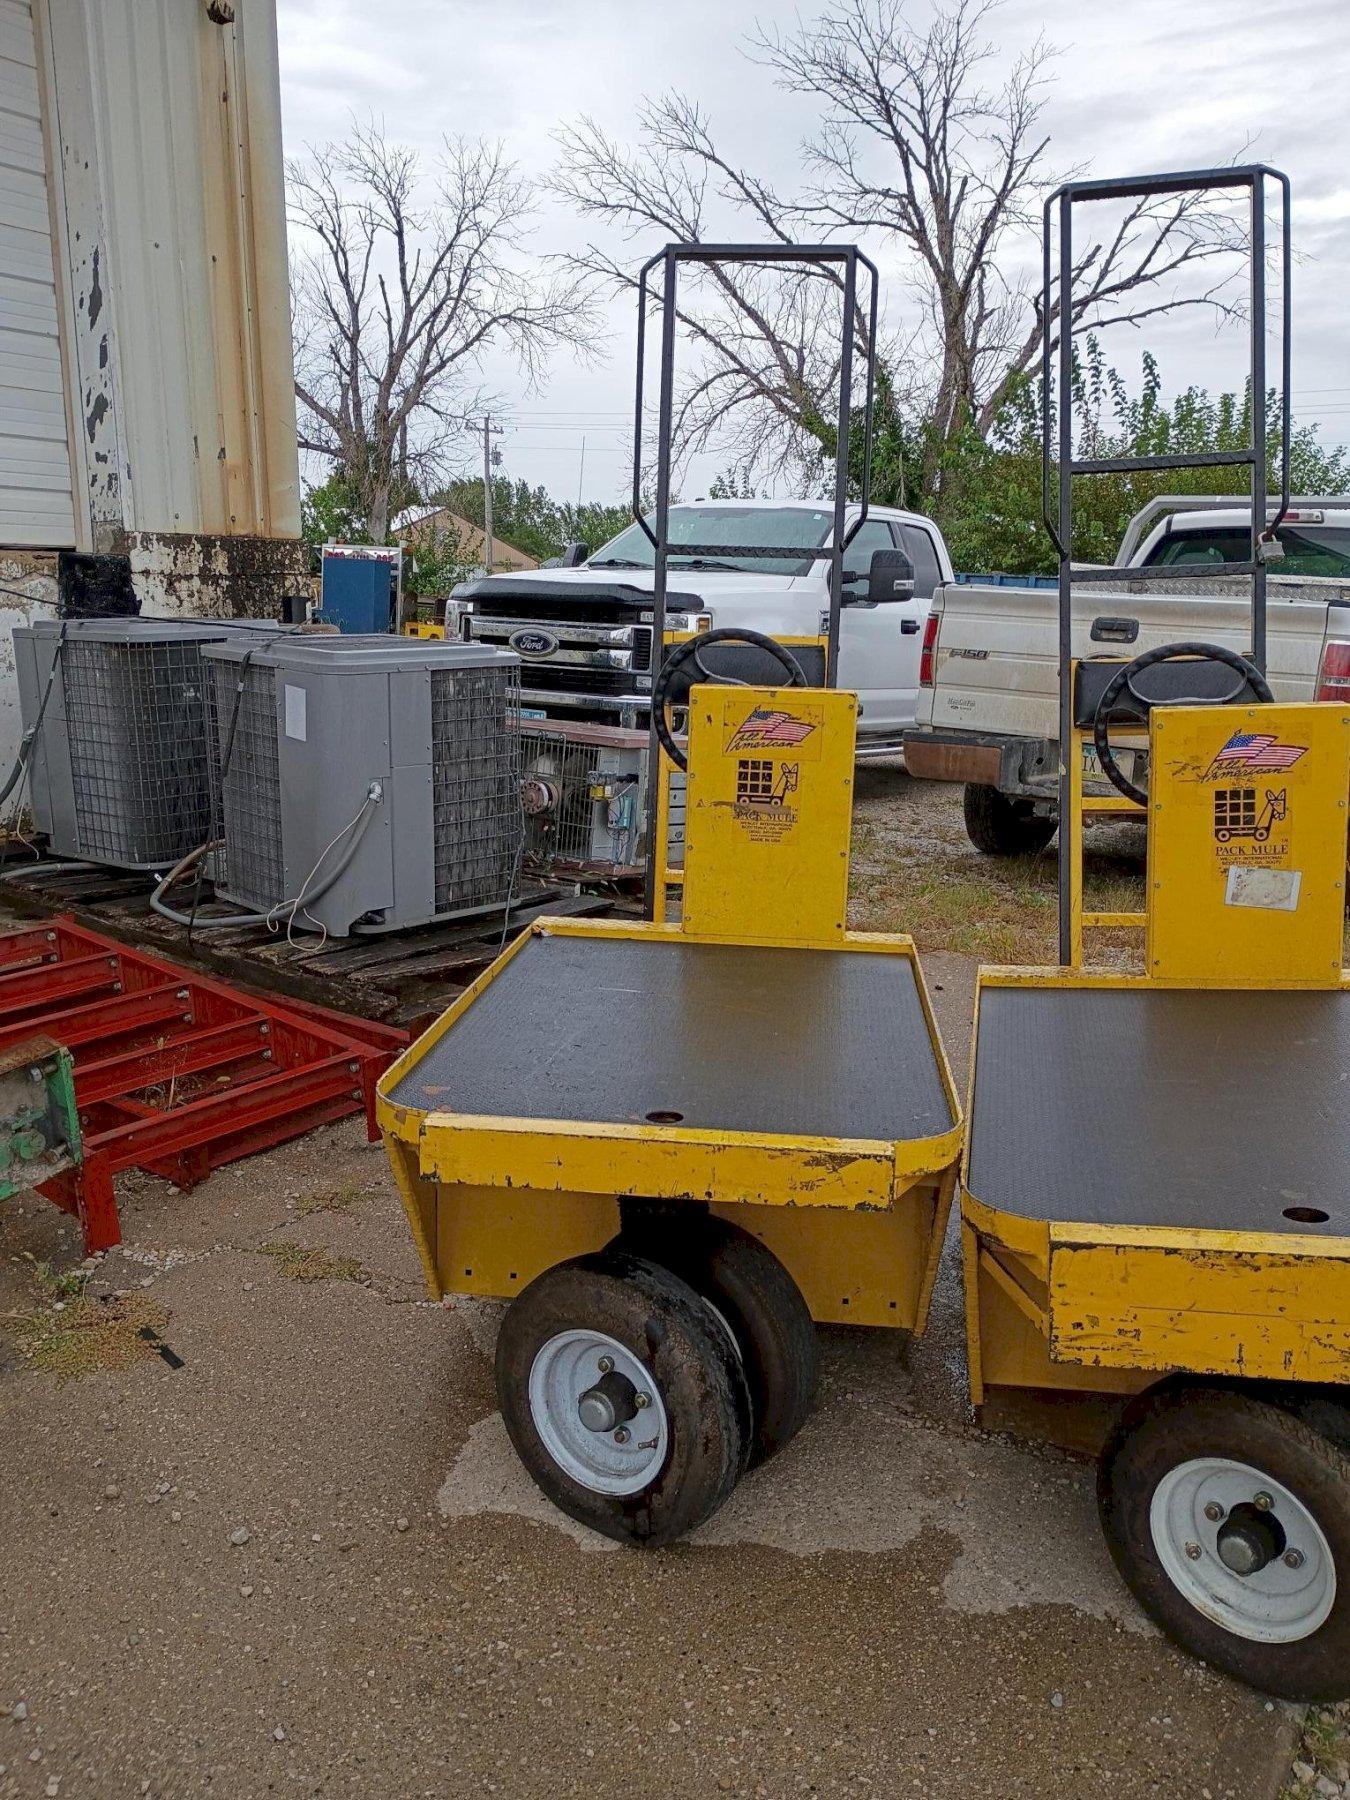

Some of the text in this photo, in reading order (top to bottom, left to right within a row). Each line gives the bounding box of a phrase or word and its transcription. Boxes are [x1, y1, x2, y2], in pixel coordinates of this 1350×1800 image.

[520, 635, 544, 650] Ford
[730, 740, 803, 752] American
[1202, 767, 1293, 783] American
[1216, 844, 1288, 855] PACK MULE
